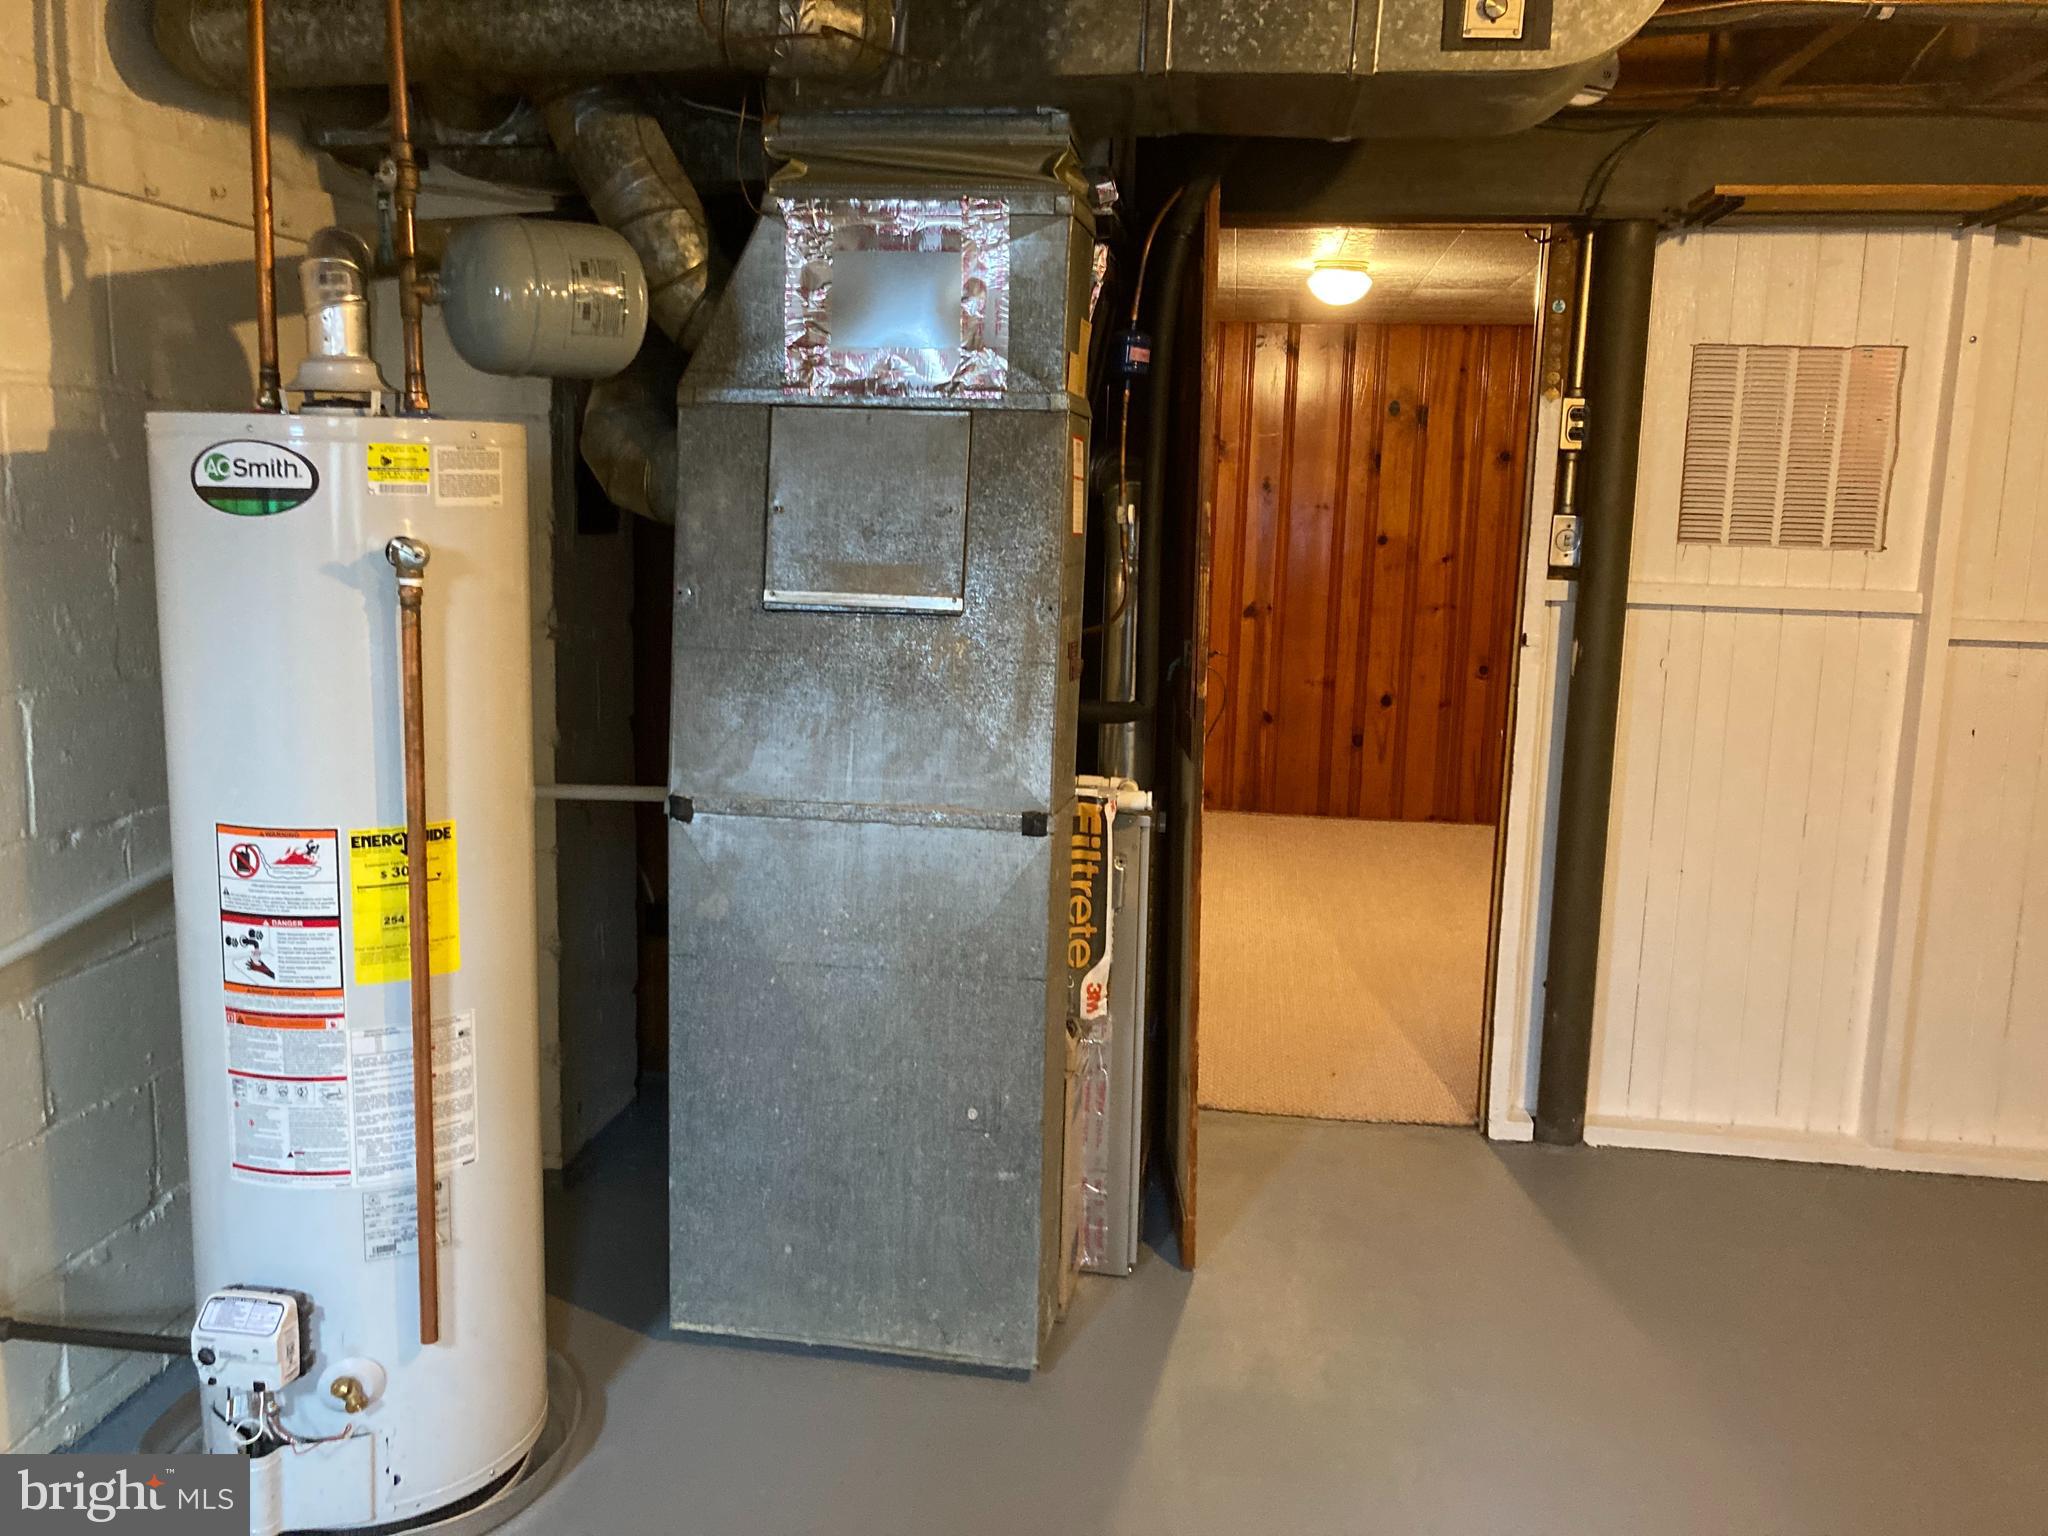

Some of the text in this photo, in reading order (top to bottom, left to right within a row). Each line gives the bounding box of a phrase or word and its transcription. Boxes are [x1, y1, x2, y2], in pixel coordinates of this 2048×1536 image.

[233, 458, 299, 479] Smith
[1067, 802, 1103, 969] Filtrete
[271, 919, 304, 928] DANGER
[383, 915, 405, 925] 254
[1086, 982, 1103, 1014] 3M
